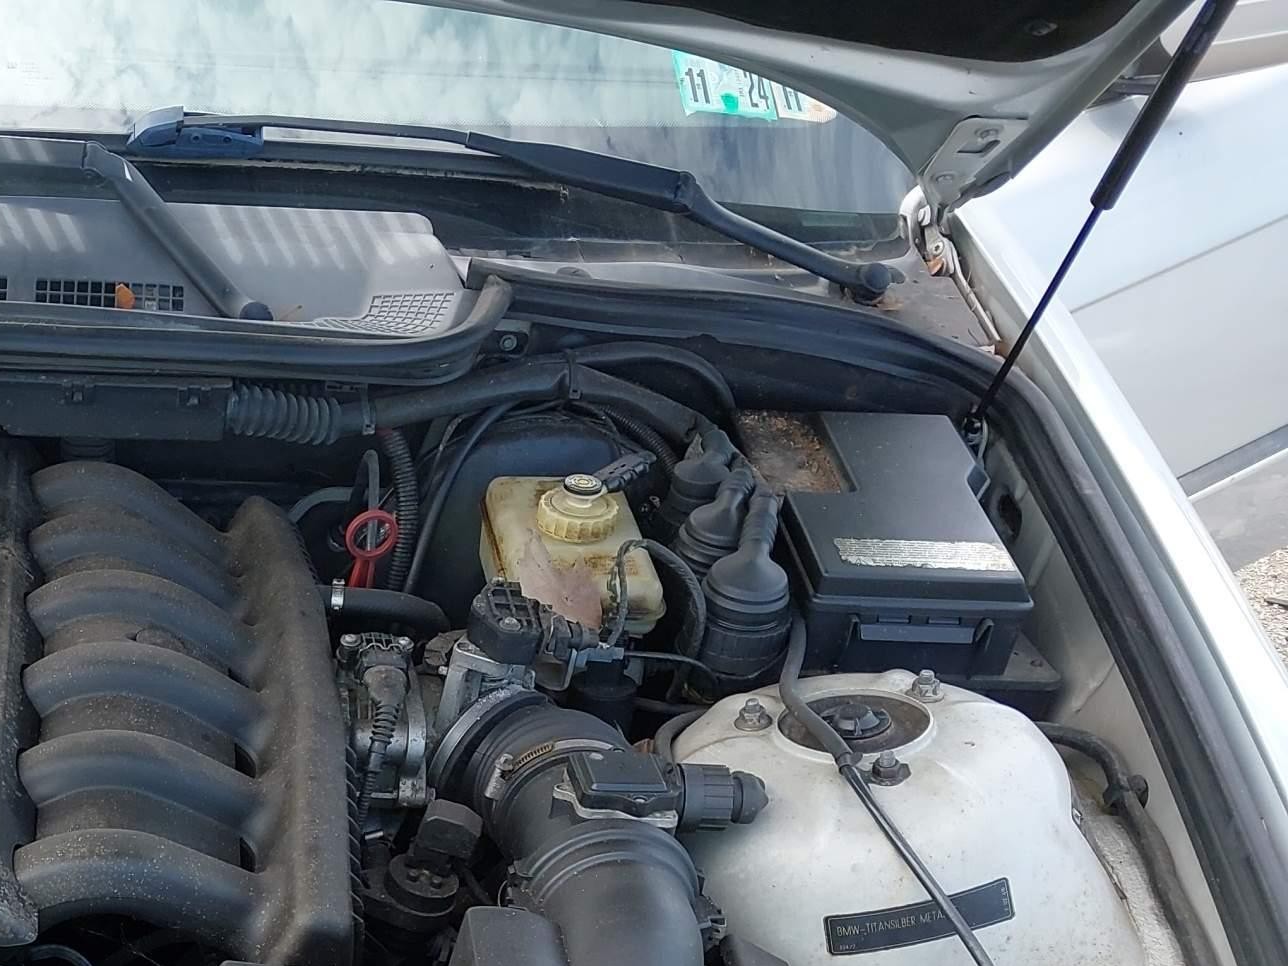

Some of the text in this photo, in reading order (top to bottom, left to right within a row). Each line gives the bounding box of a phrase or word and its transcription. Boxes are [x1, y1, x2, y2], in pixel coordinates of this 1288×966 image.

[685, 67, 770, 110] 11 24
[919, 910, 946, 924] META
